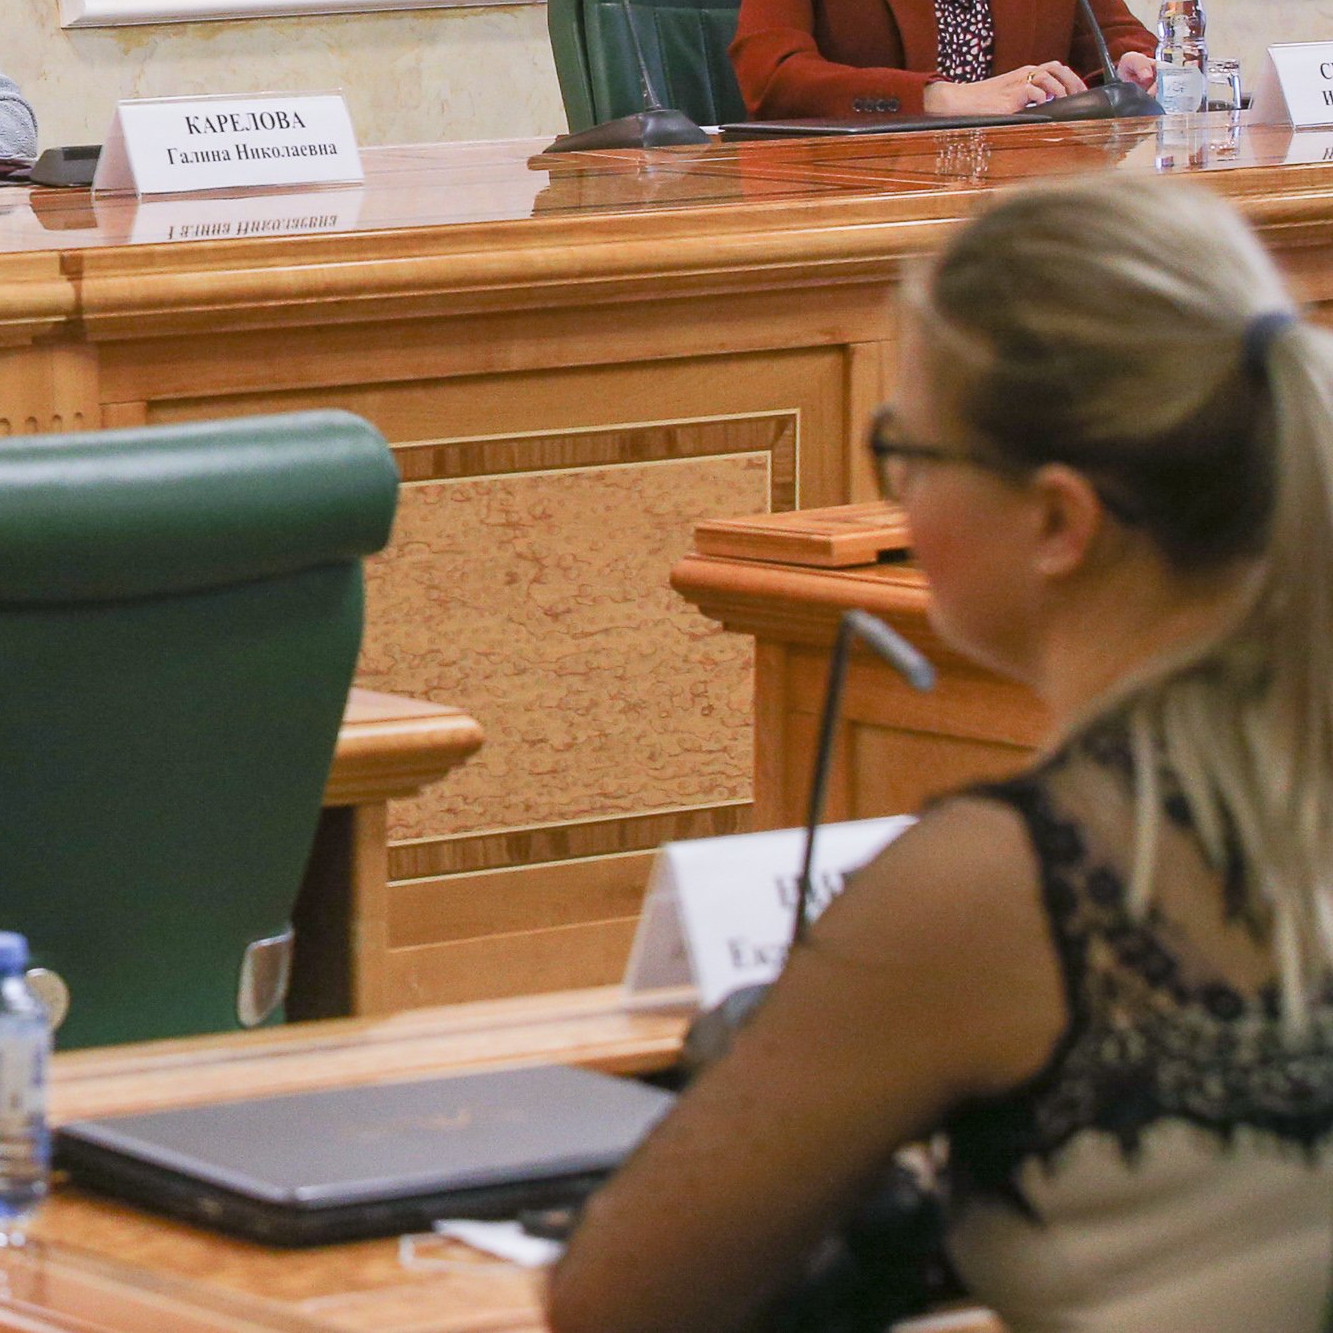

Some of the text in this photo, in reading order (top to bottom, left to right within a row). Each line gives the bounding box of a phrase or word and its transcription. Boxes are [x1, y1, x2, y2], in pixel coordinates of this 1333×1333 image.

[185, 111, 306, 135] КАРЕЛОВА
[166, 142, 338, 165] Галина Николаевна
